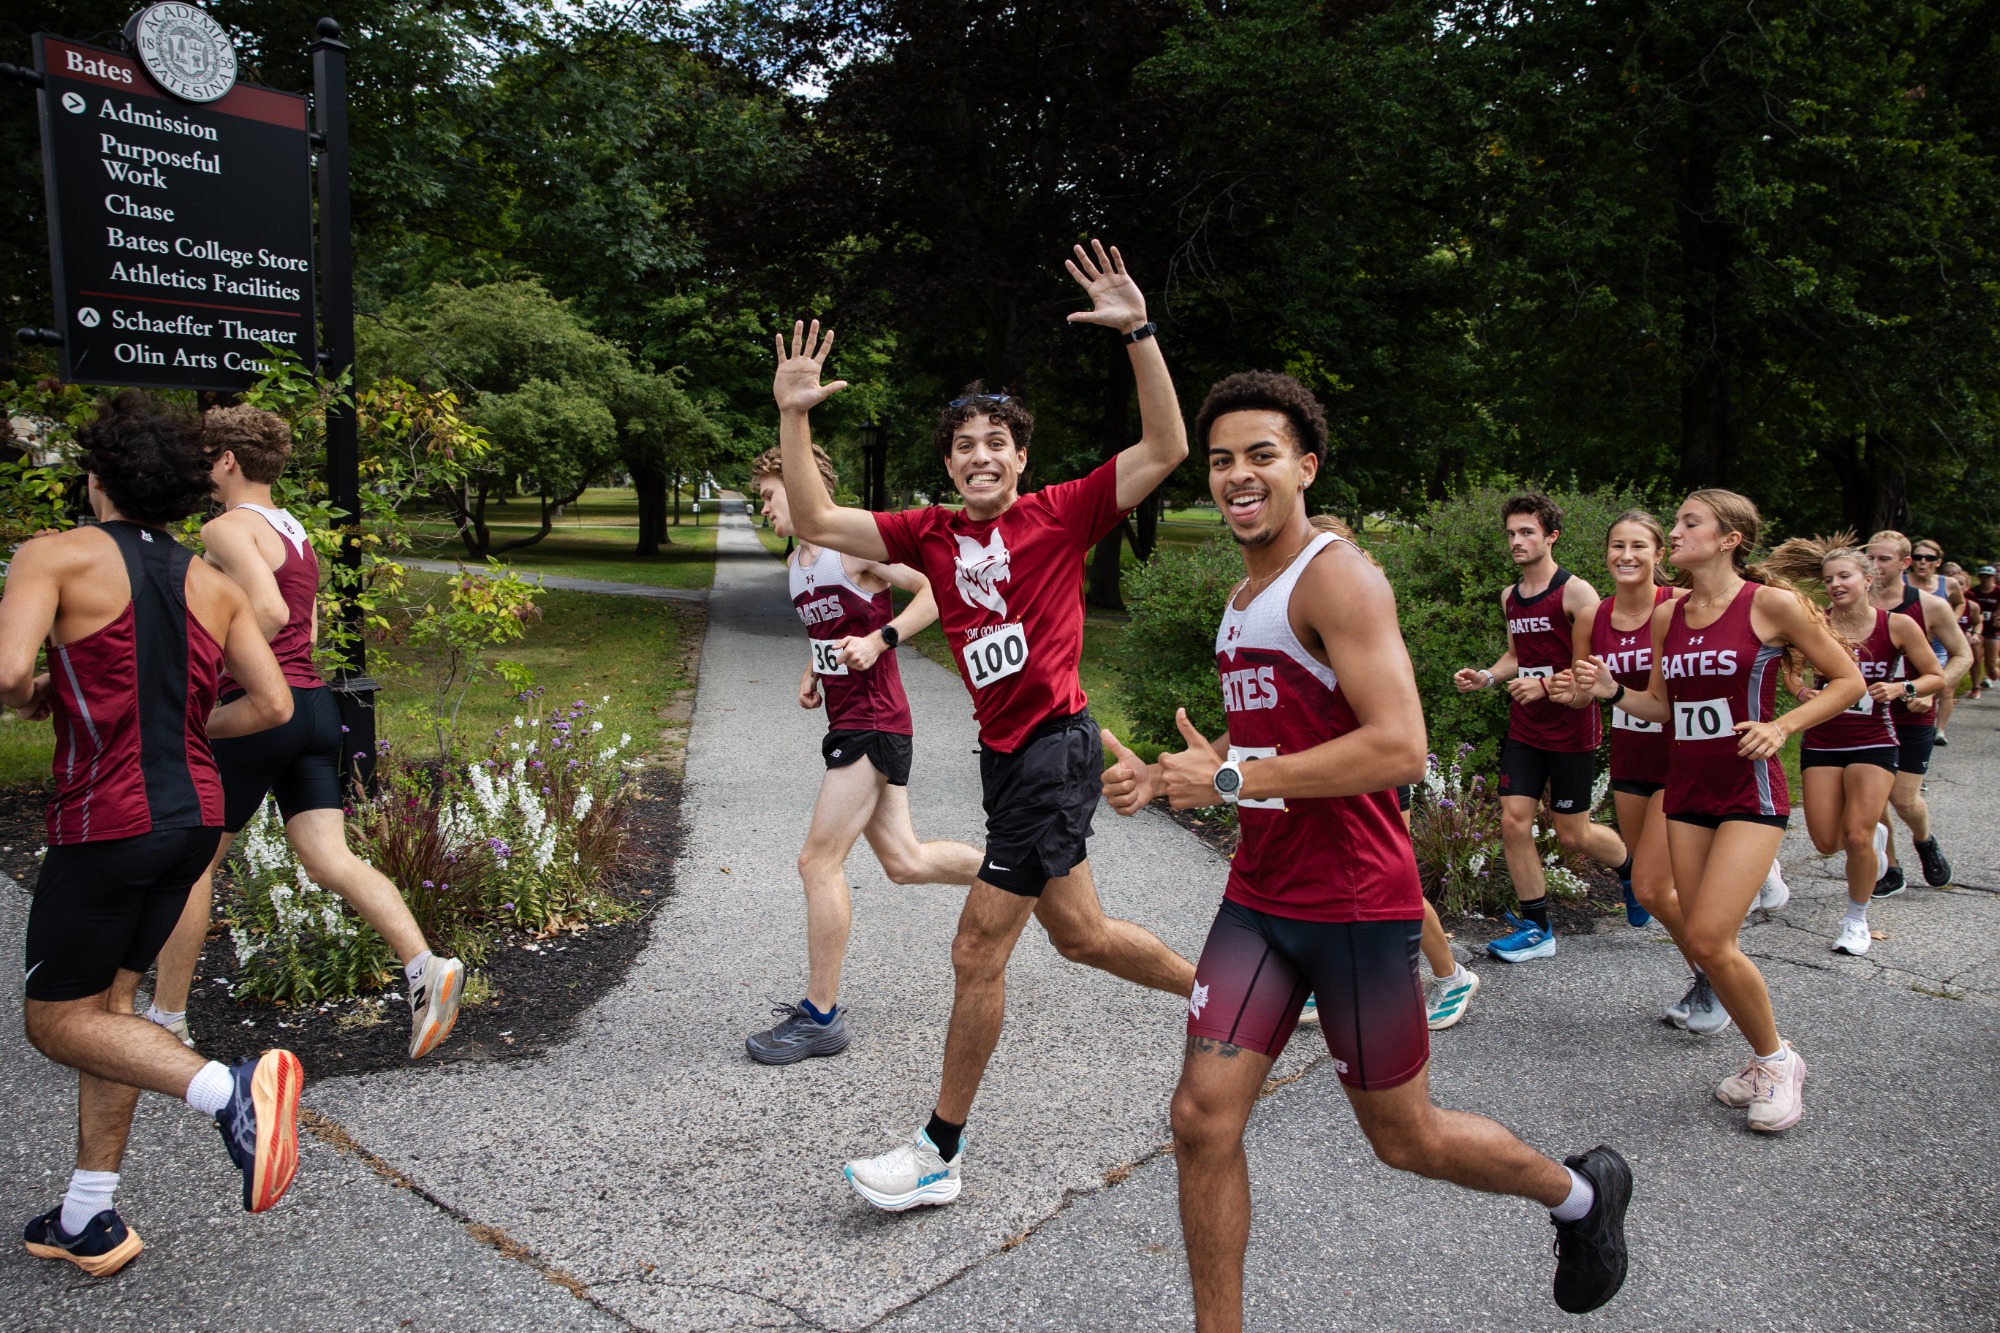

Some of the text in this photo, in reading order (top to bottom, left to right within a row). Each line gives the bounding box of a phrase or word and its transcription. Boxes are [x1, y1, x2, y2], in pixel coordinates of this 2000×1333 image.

[141, 36, 155, 50] 18
[144, 5, 228, 52] ACADEMIA
[65, 50, 133, 84] Bates
[147, 57, 232, 98] BATESINA
[220, 56, 234, 70] 55
[98, 99, 219, 141] Admission
[100, 133, 222, 175] Purposeful
[101, 158, 168, 189] Work
[104, 194, 175, 222] Chase
[106, 227, 309, 272] Bates College Store
[109, 261, 300, 301] Athletics Facilities
[112, 310, 298, 344] Schaeffer Theater
[114, 343, 166, 365] Olin
[172, 348, 217, 369] Arts
[1509, 616, 1551, 634] BATES
[814, 643, 839, 671] 36
[970, 635, 1024, 682] 100
[1661, 649, 1738, 680] BATES
[1220, 666, 1278, 713] ATES
[1681, 705, 1721, 737] 70
[916, 1169, 949, 1189] HOKA
